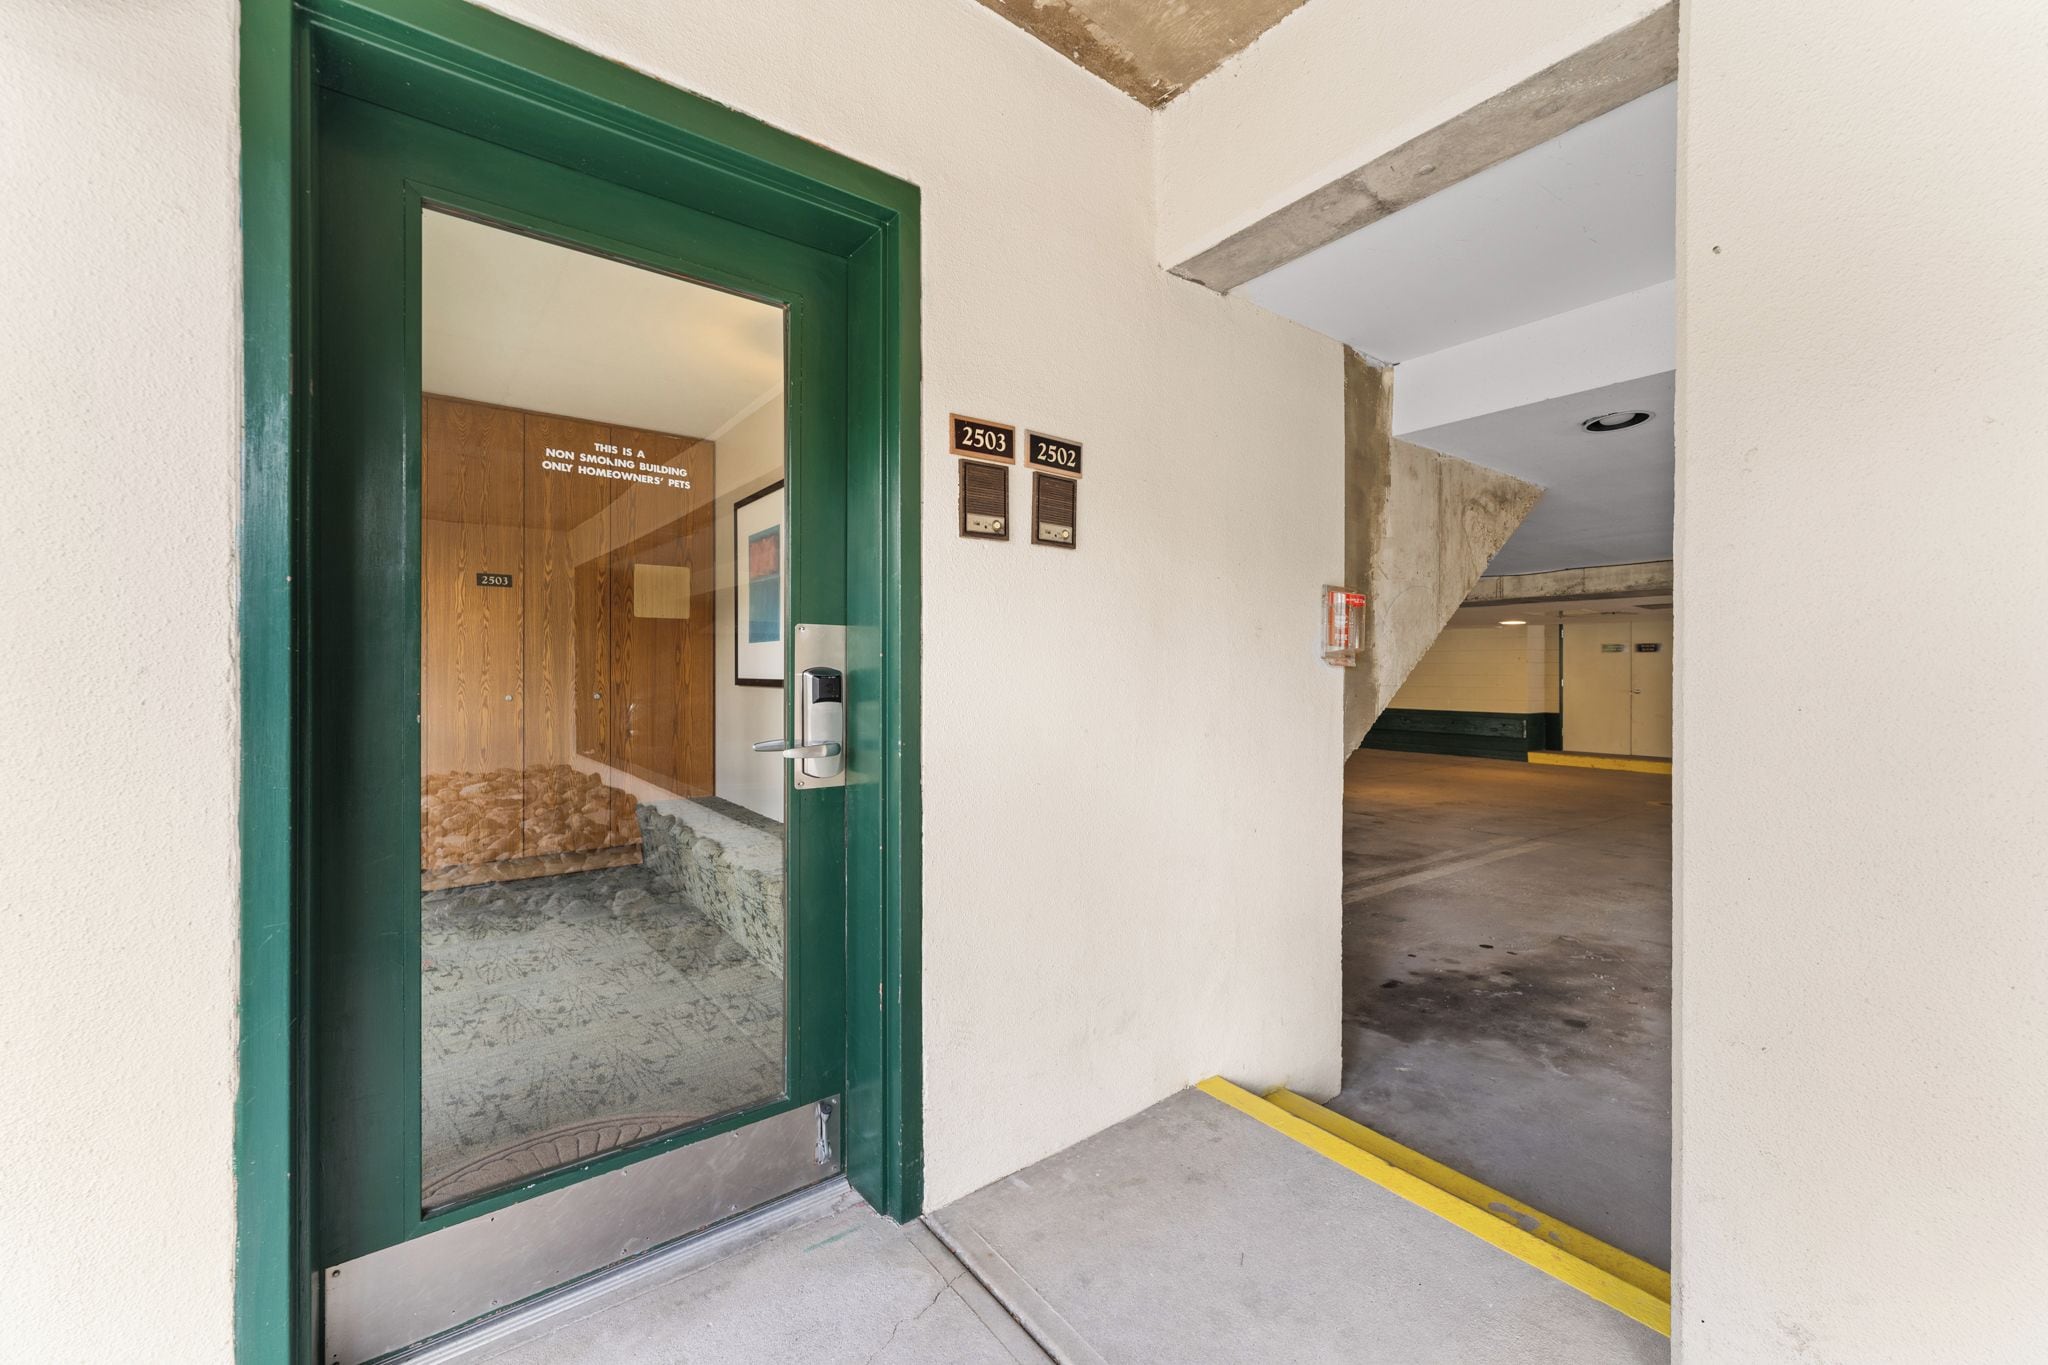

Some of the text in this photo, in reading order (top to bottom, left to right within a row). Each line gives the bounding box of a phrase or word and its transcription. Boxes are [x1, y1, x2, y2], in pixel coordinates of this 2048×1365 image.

[594, 442, 646, 459] THIS IS A
[962, 426, 1006, 452] 2503
[545, 447, 575, 460] NON
[639, 462, 688, 477] BUILDING
[1037, 442, 1076, 468] 2502
[541, 460, 691, 490] ONLY HOMEOWNERS' PETS
[481, 575, 509, 586] 2503
